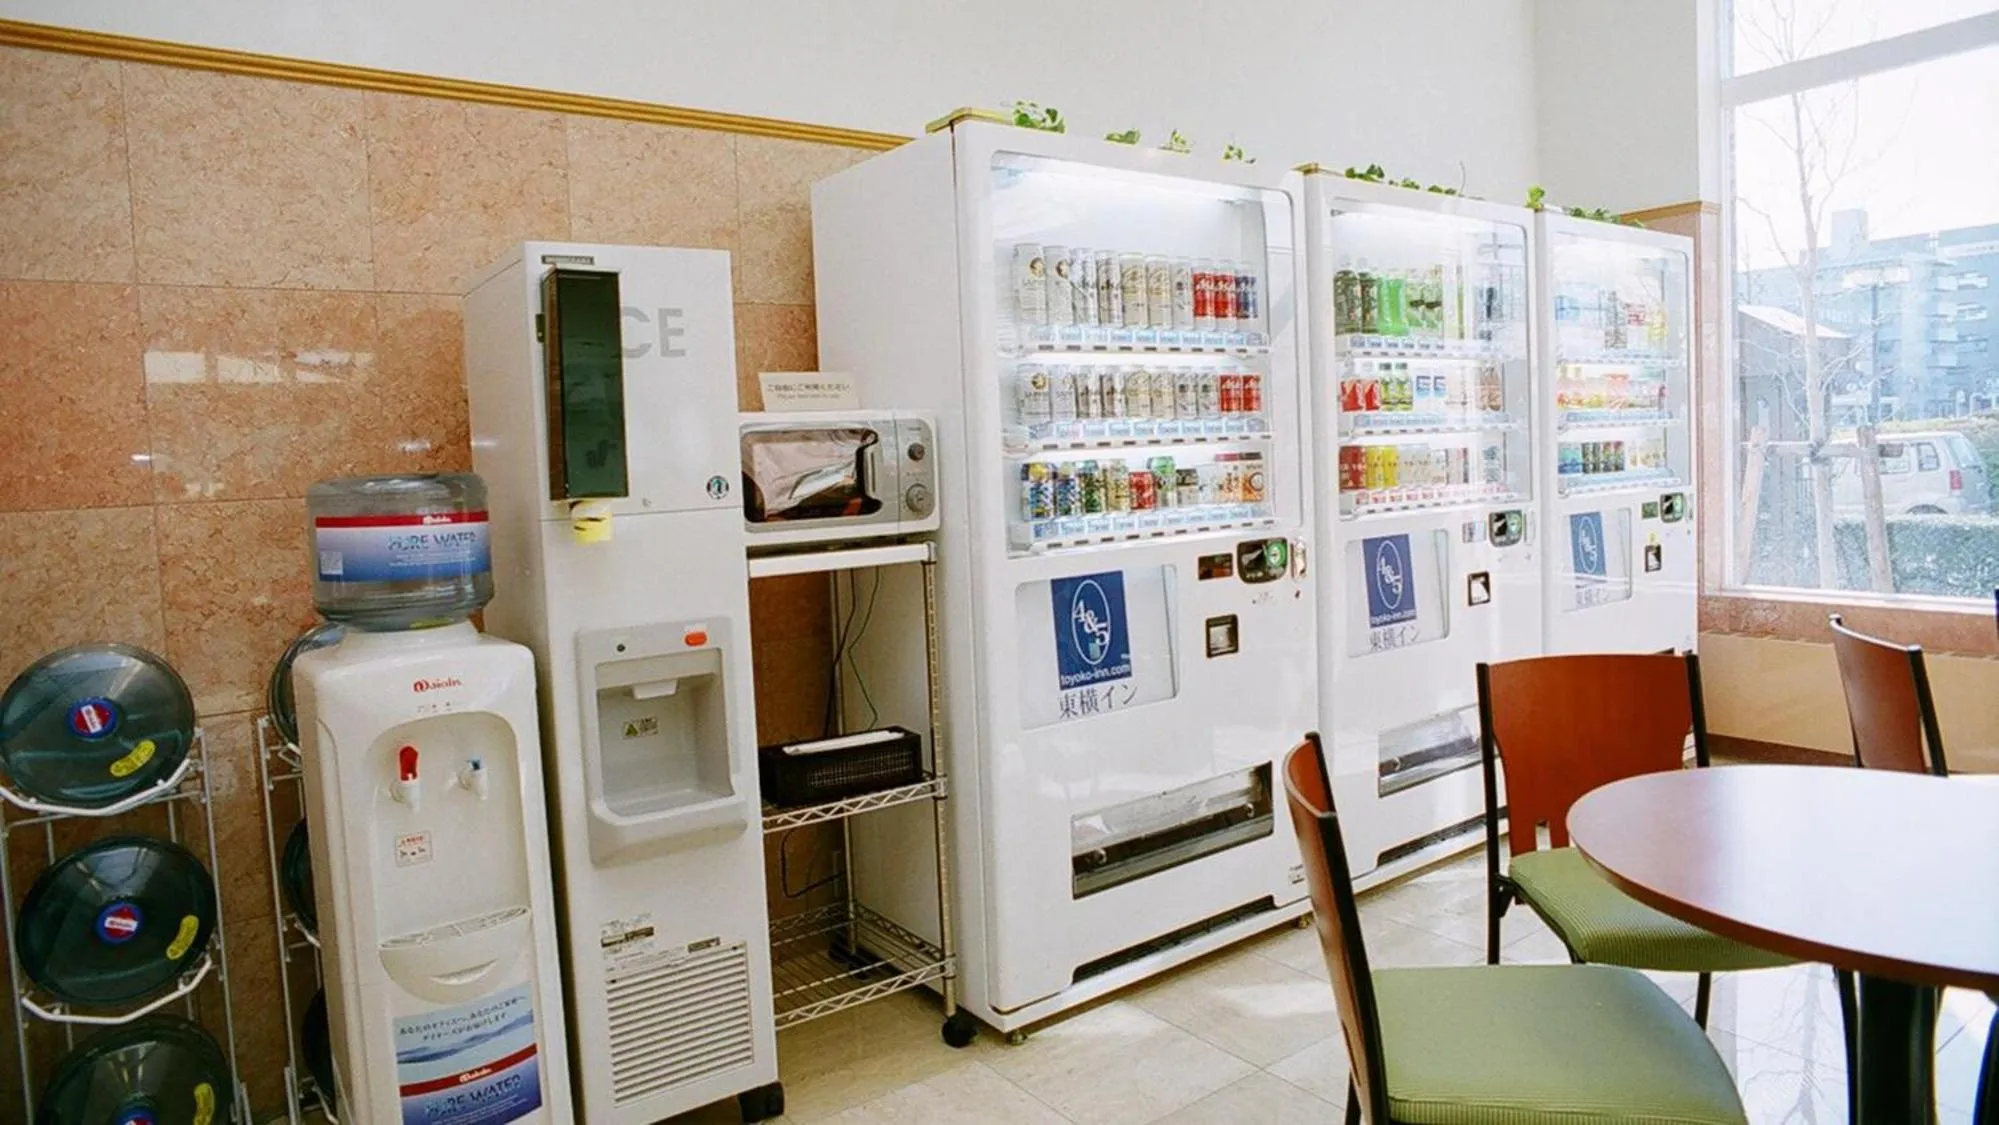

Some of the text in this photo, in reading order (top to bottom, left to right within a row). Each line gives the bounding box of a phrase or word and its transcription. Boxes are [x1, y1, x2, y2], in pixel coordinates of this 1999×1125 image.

[622, 306, 686, 358] CE
[1074, 599, 1110, 646] 4&5
[1061, 663, 1131, 685] toyoko-inn.com
[1058, 683, 1138, 720] 東横イン
